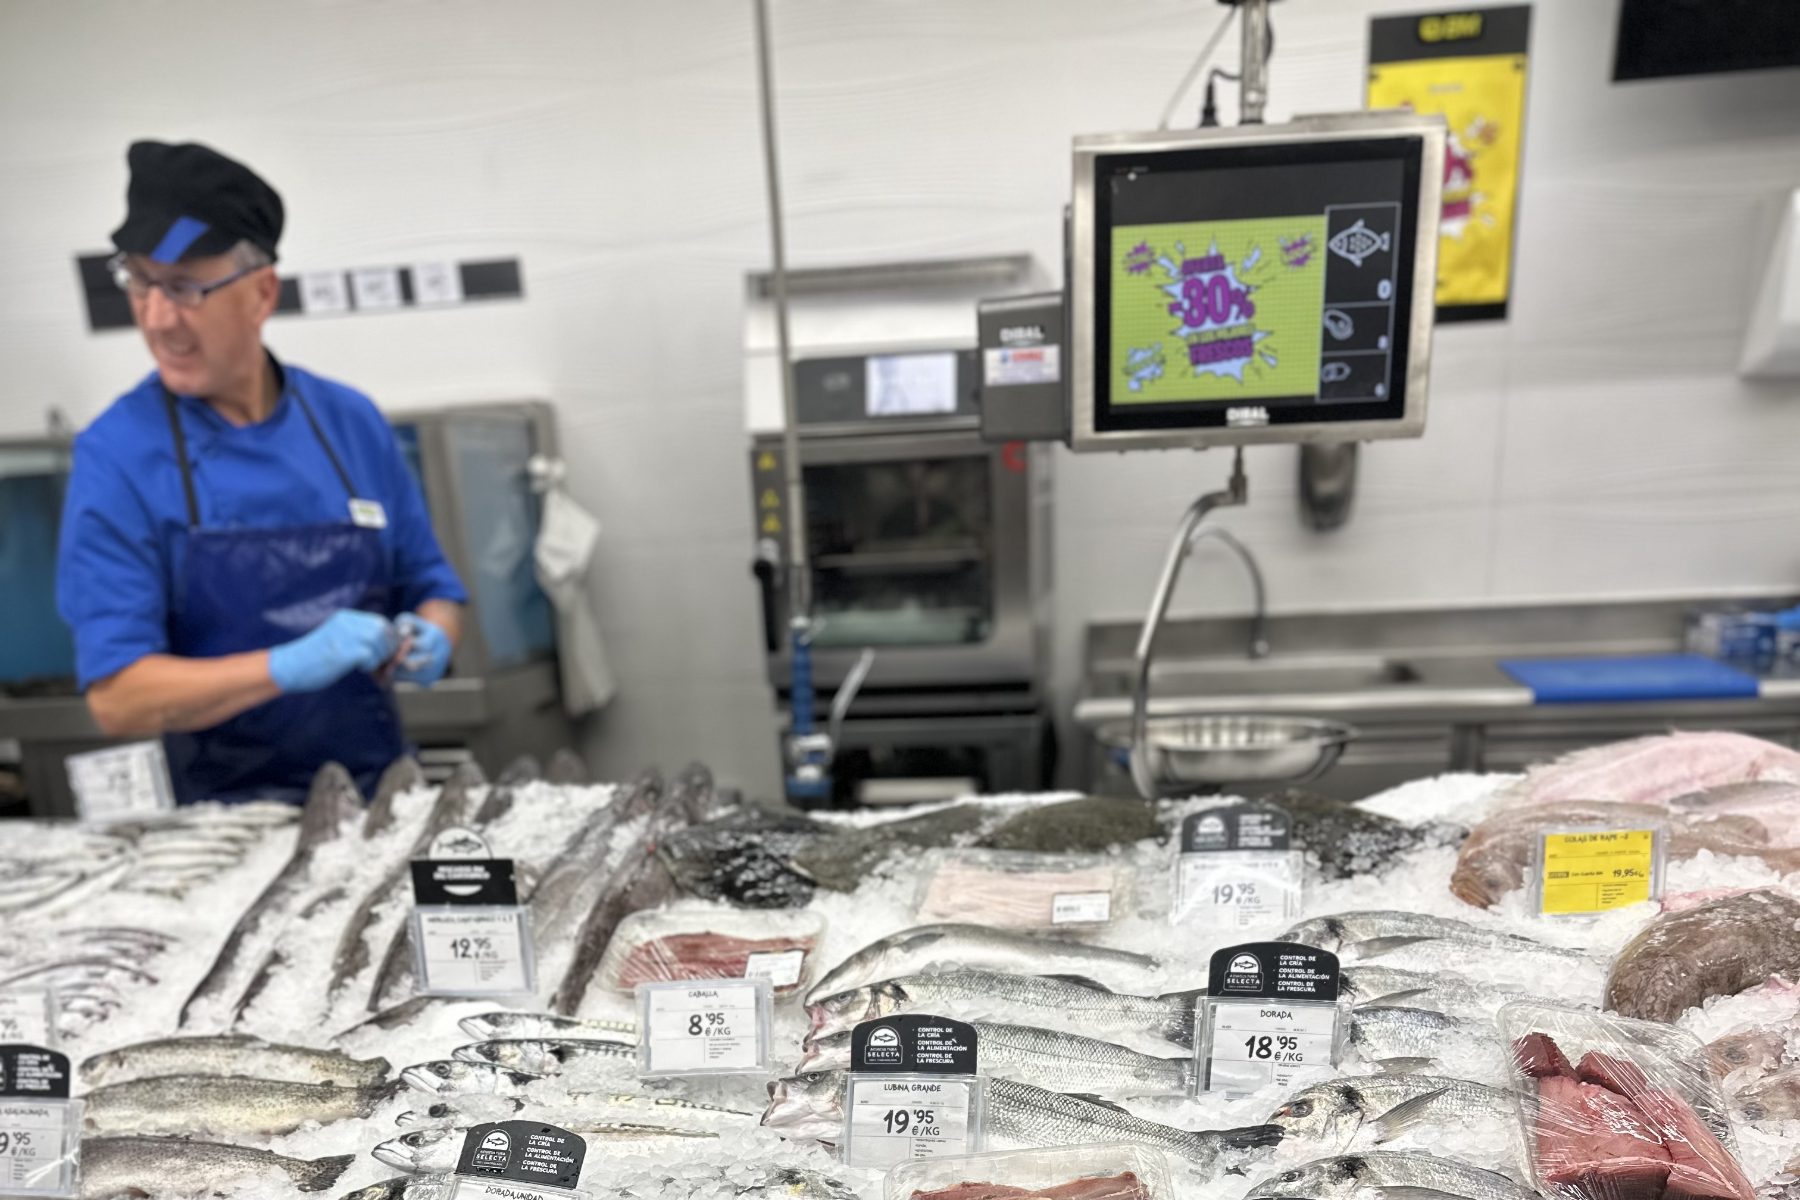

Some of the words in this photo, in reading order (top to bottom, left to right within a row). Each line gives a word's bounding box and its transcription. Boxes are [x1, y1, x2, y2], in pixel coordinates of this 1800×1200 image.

[688, 990, 719, 999] CABALLA
[1260, 1010, 1293, 1020] DORADA
[884, 1083, 910, 1092] LUBINA
[911, 1084, 941, 1094] GRANDE
[531, 1135, 555, 1143] CONTROL
[526, 1147, 552, 1155] CONTROL
[476, 1154, 507, 1162] SELECTA
[523, 1160, 548, 1168] CONTROL
[529, 1166, 558, 1175] FRESCURA
